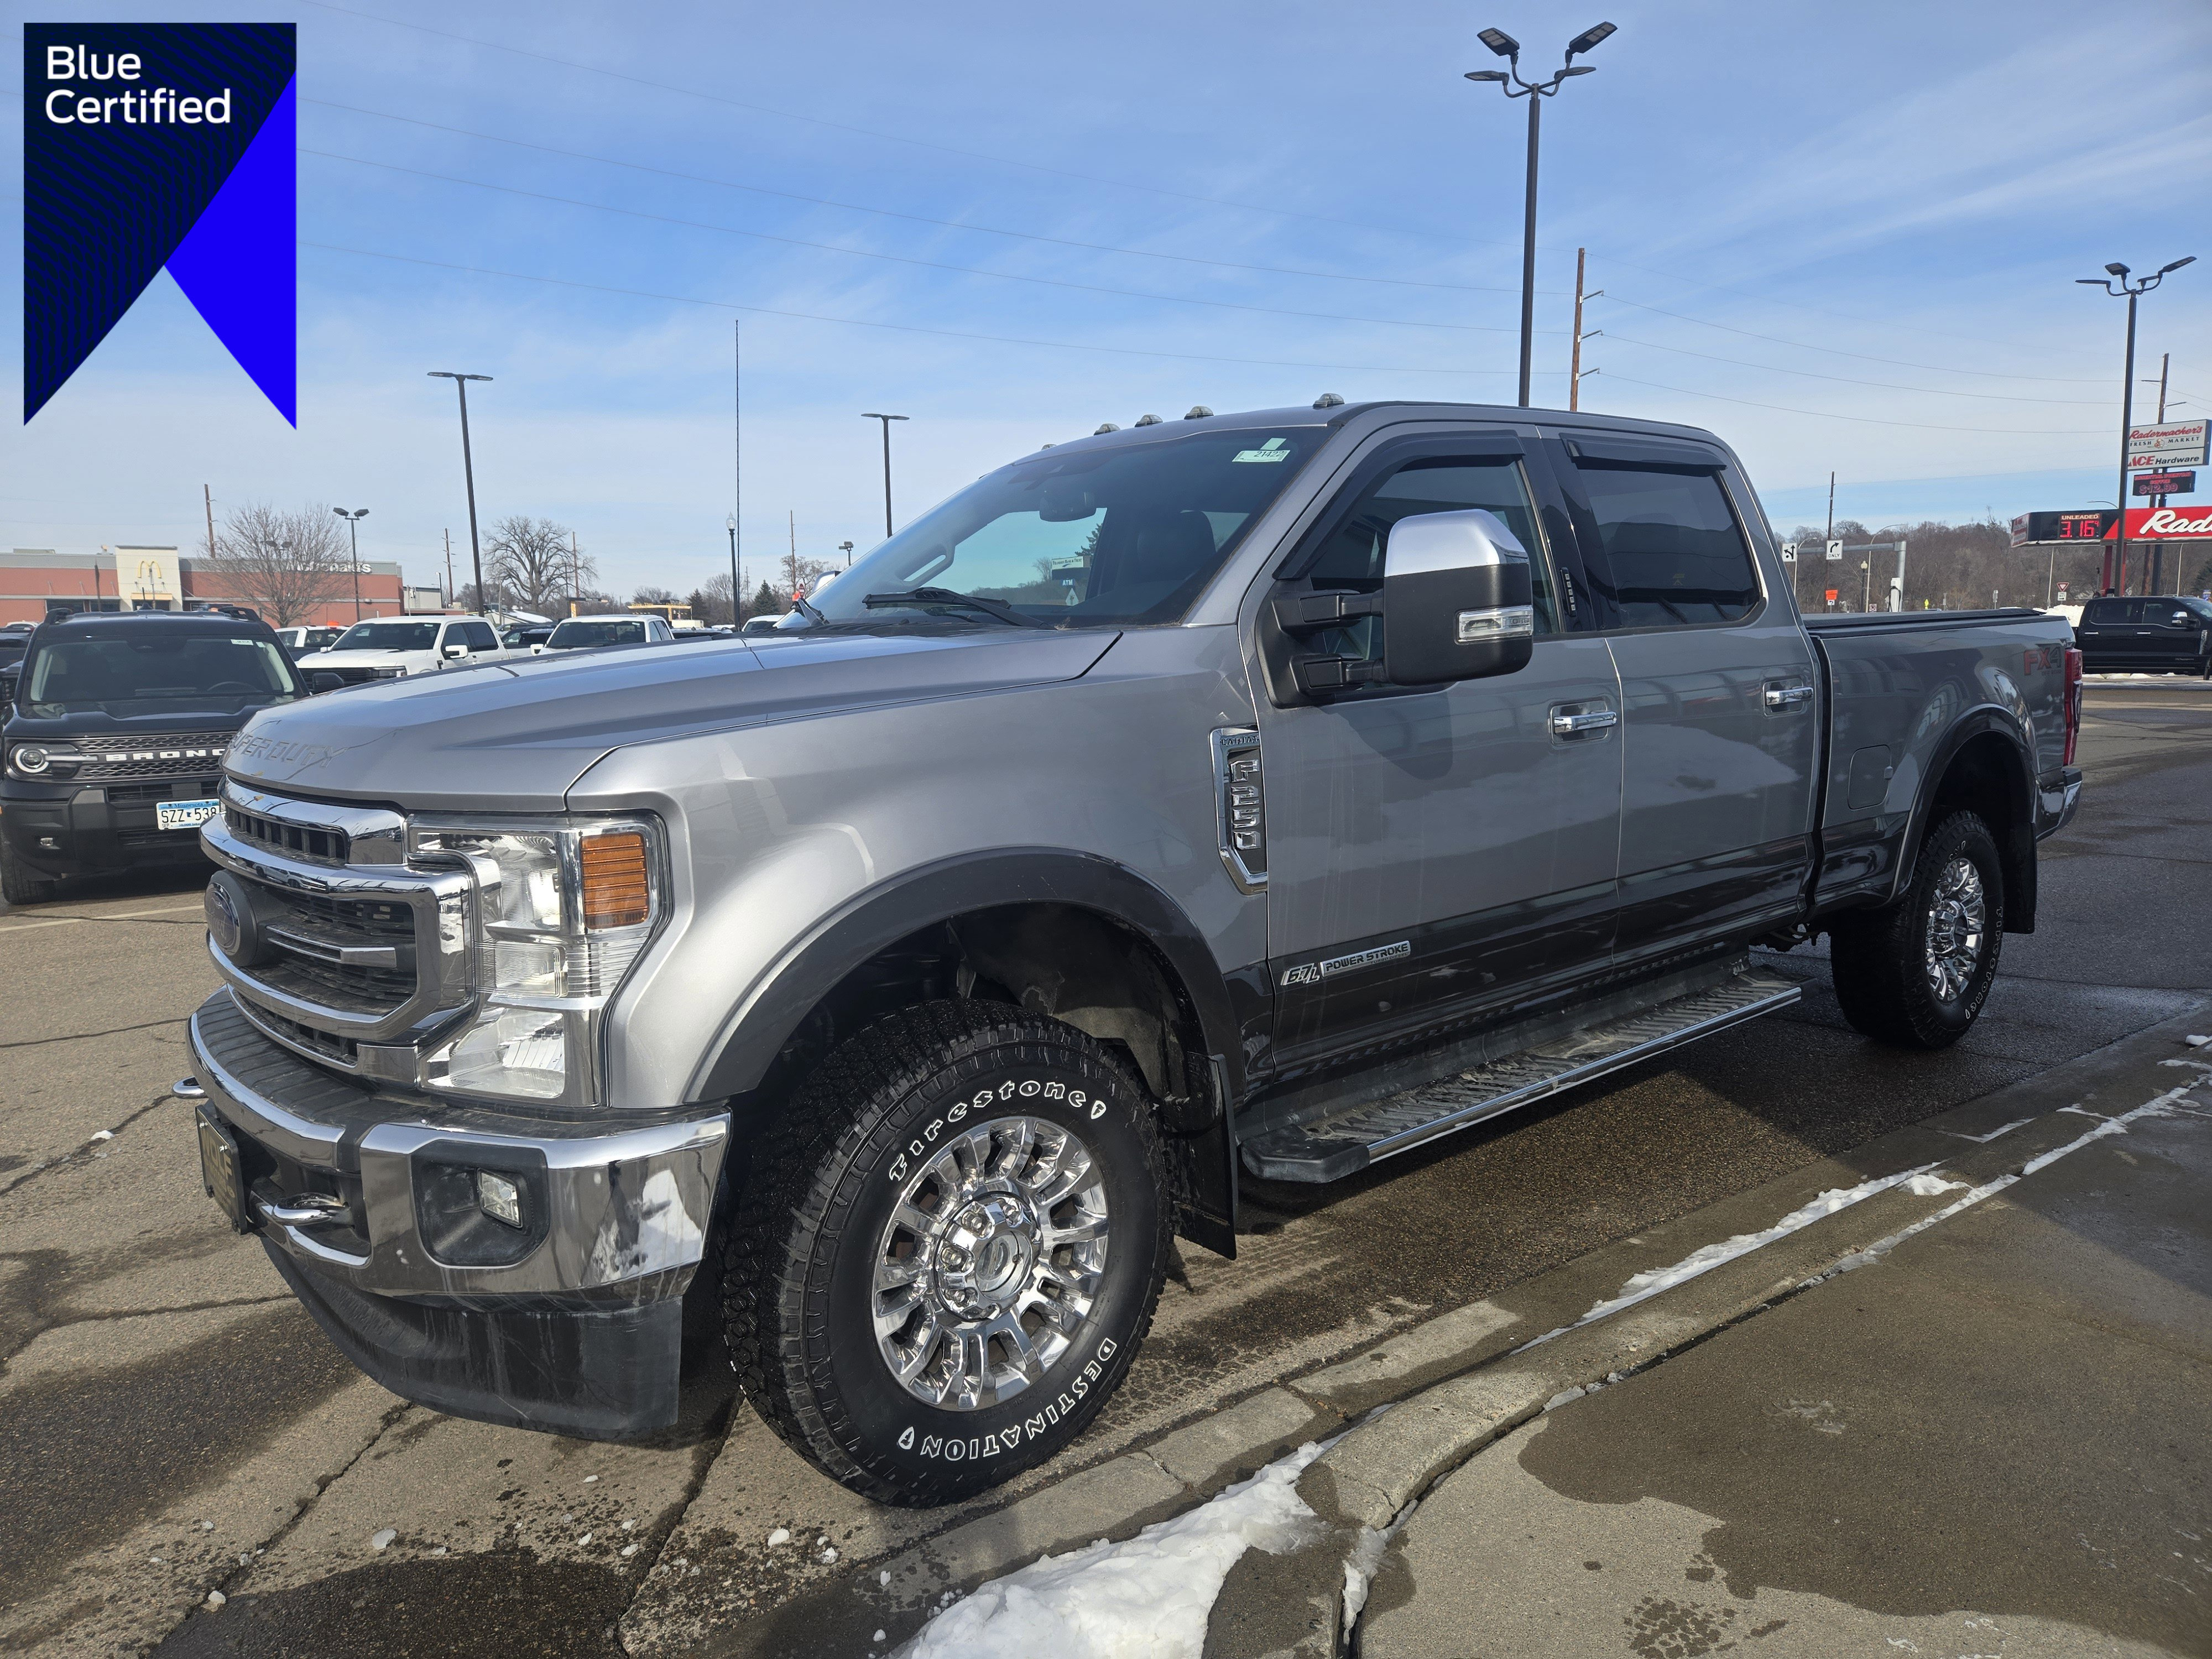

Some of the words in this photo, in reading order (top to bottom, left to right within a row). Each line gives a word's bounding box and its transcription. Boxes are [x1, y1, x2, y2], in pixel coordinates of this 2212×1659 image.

[2129, 426, 2203, 440] Radermacher's
[2128, 456, 2155, 467] ACE
[2155, 456, 2200, 465] Hardware
[2139, 483, 2178, 494] $12.99
[2023, 646, 2062, 676] FX4
[1220, 734, 1260, 747] LARIAT
[106, 748, 226, 761] BRONC
[1286, 963, 1321, 985] 6.7L
[1325, 955, 1364, 972] POWER
[1366, 943, 1409, 961] STROKE
[920, 1338, 1117, 1461] DESTINATION
